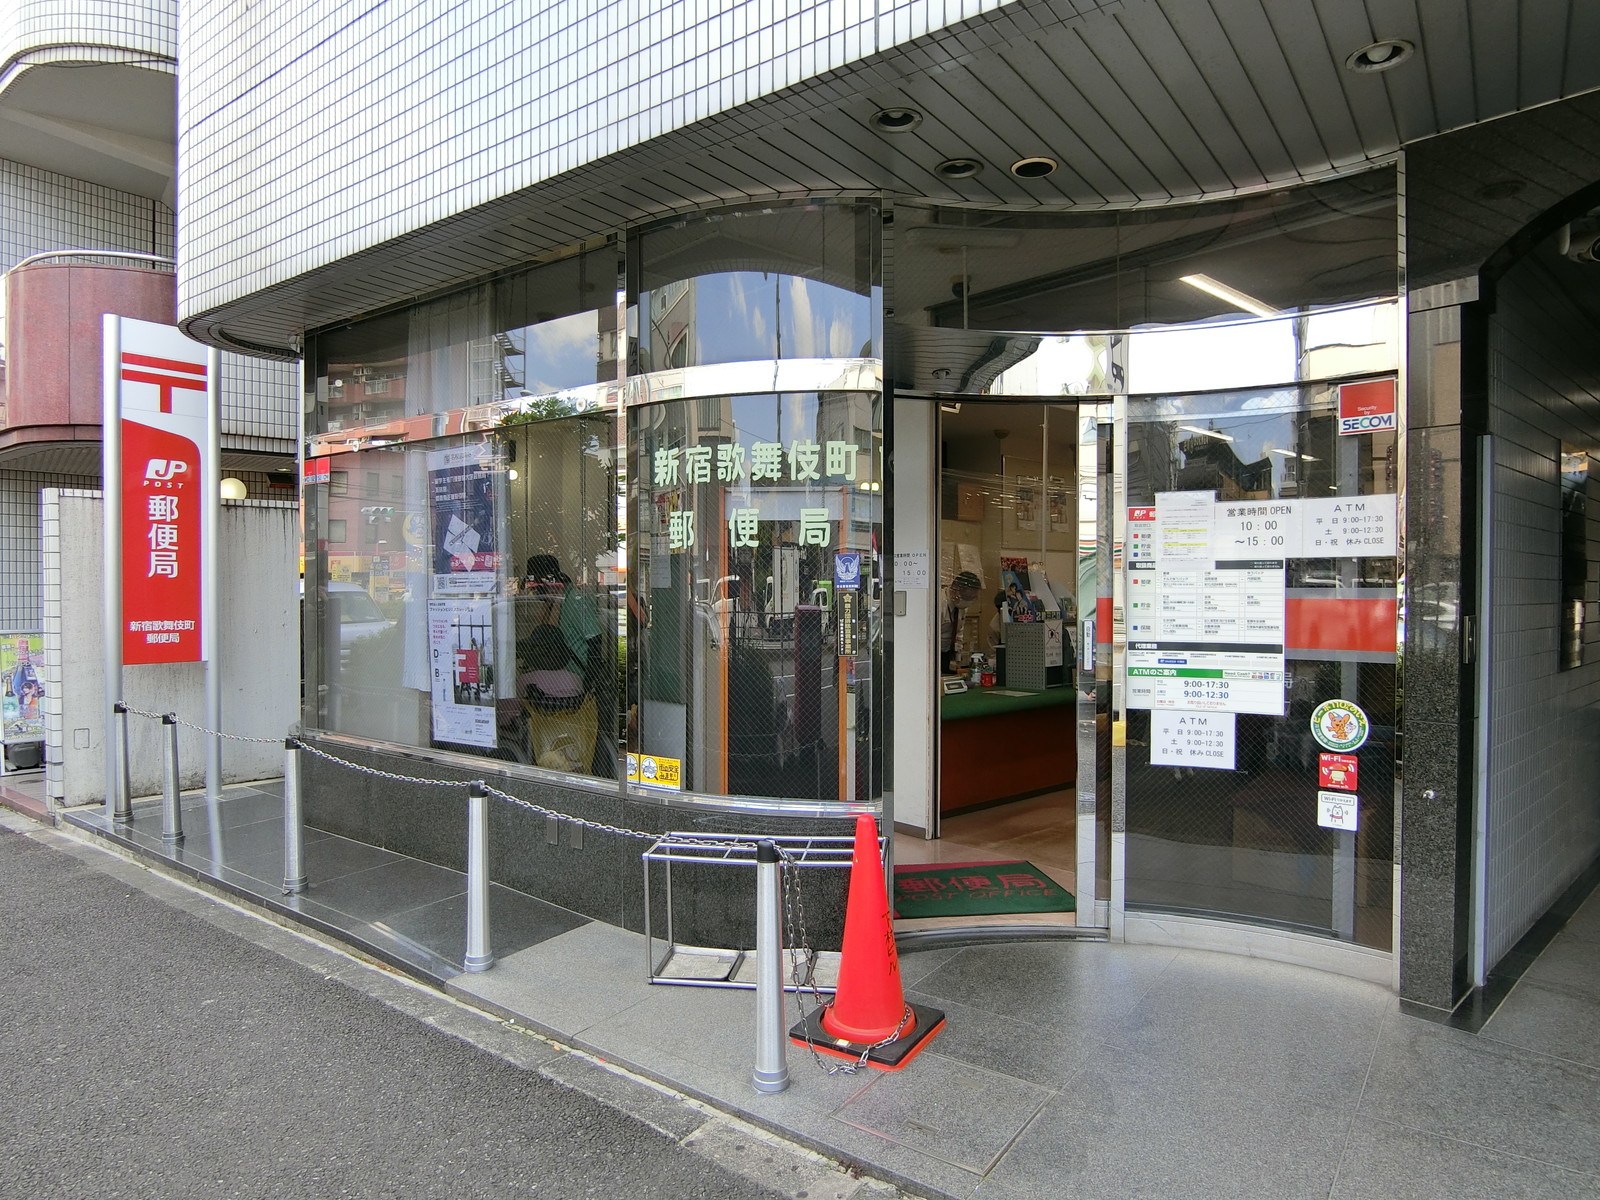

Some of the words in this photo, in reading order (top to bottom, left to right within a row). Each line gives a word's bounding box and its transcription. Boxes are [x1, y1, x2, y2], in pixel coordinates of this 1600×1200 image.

[1342, 415, 1392, 430] SECOM
[654, 439, 859, 487] 新宿歌舞伎町
[143, 480, 184, 489] POST
[1226, 507, 1268, 517] 営業時間
[1270, 506, 1292, 515] OPEN
[1333, 503, 1366, 513] ATM
[1342, 515, 1384, 524] 9:00-17:30
[1342, 527, 1384, 535] 9:00-12:30
[148, 495, 179, 578] 郵便局
[1346, 538, 1362, 546] 休み
[1363, 537, 1384, 545] CLOSE
[129, 620, 195, 632] 新宿歌舞伎町
[146, 633, 180, 644] 郵便局
[1132, 668, 1177, 676] ATMのご案内
[1184, 680, 1229, 689] 9:00-17:30
[1184, 690, 1229, 699] 9:00-12:30
[1179, 717, 1207, 726] ATM
[1187, 729, 1224, 737] 9:00-17:30
[1187, 740, 1224, 748] 9:00-12:30
[900, 873, 1048, 893] 郵便局
[968, 888, 1058, 899] OFFICE
